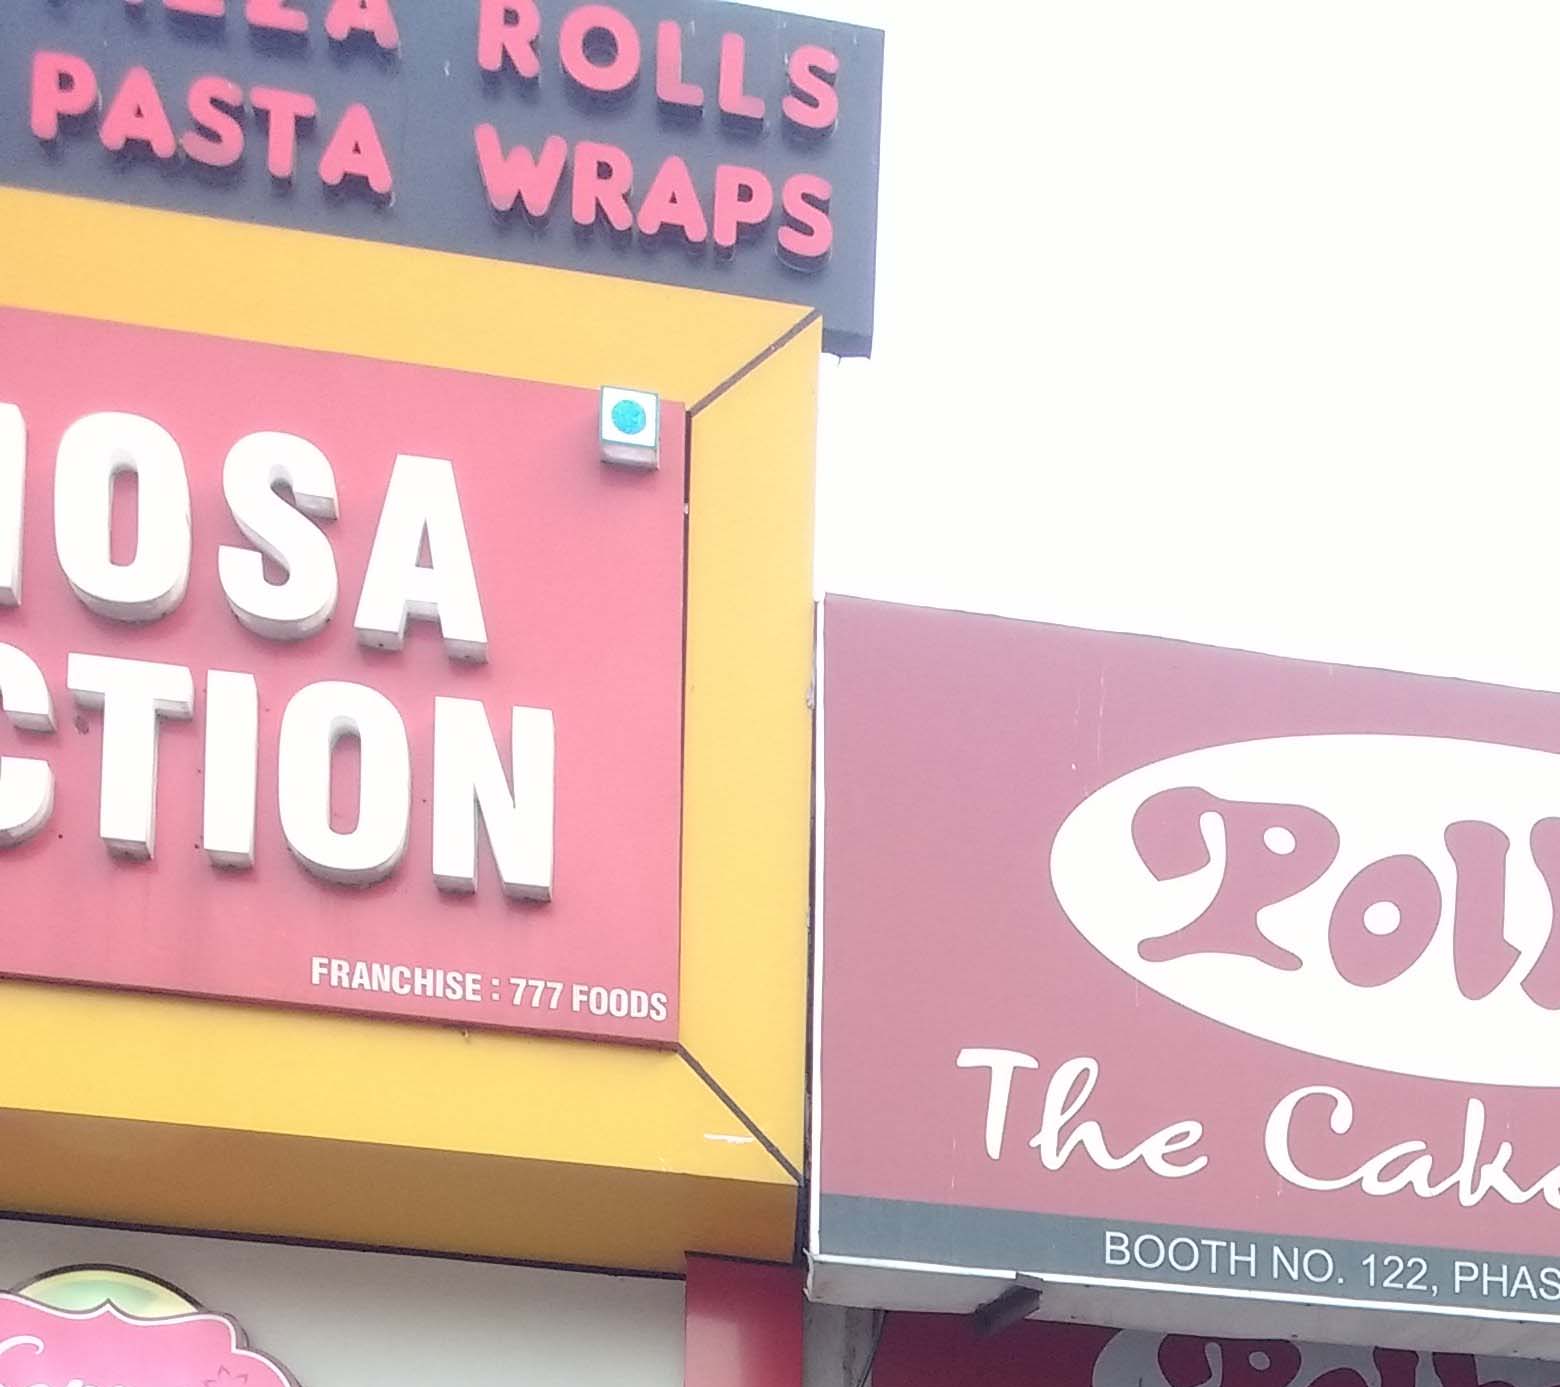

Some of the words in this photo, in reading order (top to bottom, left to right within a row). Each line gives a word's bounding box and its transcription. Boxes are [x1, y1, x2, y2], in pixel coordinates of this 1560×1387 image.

[30, 50, 393, 194] PASTA
[478, 0, 840, 131] ROLLS
[474, 123, 834, 259] WRAPS
[0, 404, 488, 662] OSA
[311, 956, 482, 1002] FRANCHISE
[509, 977, 564, 1010] 777
[571, 984, 668, 1022] FOODS
[956, 1047, 1209, 1177] The
[1104, 1231, 1257, 1277] BOOTH
[1272, 1247, 1344, 1284] NO.
[1361, 1254, 1438, 1296] 122,
